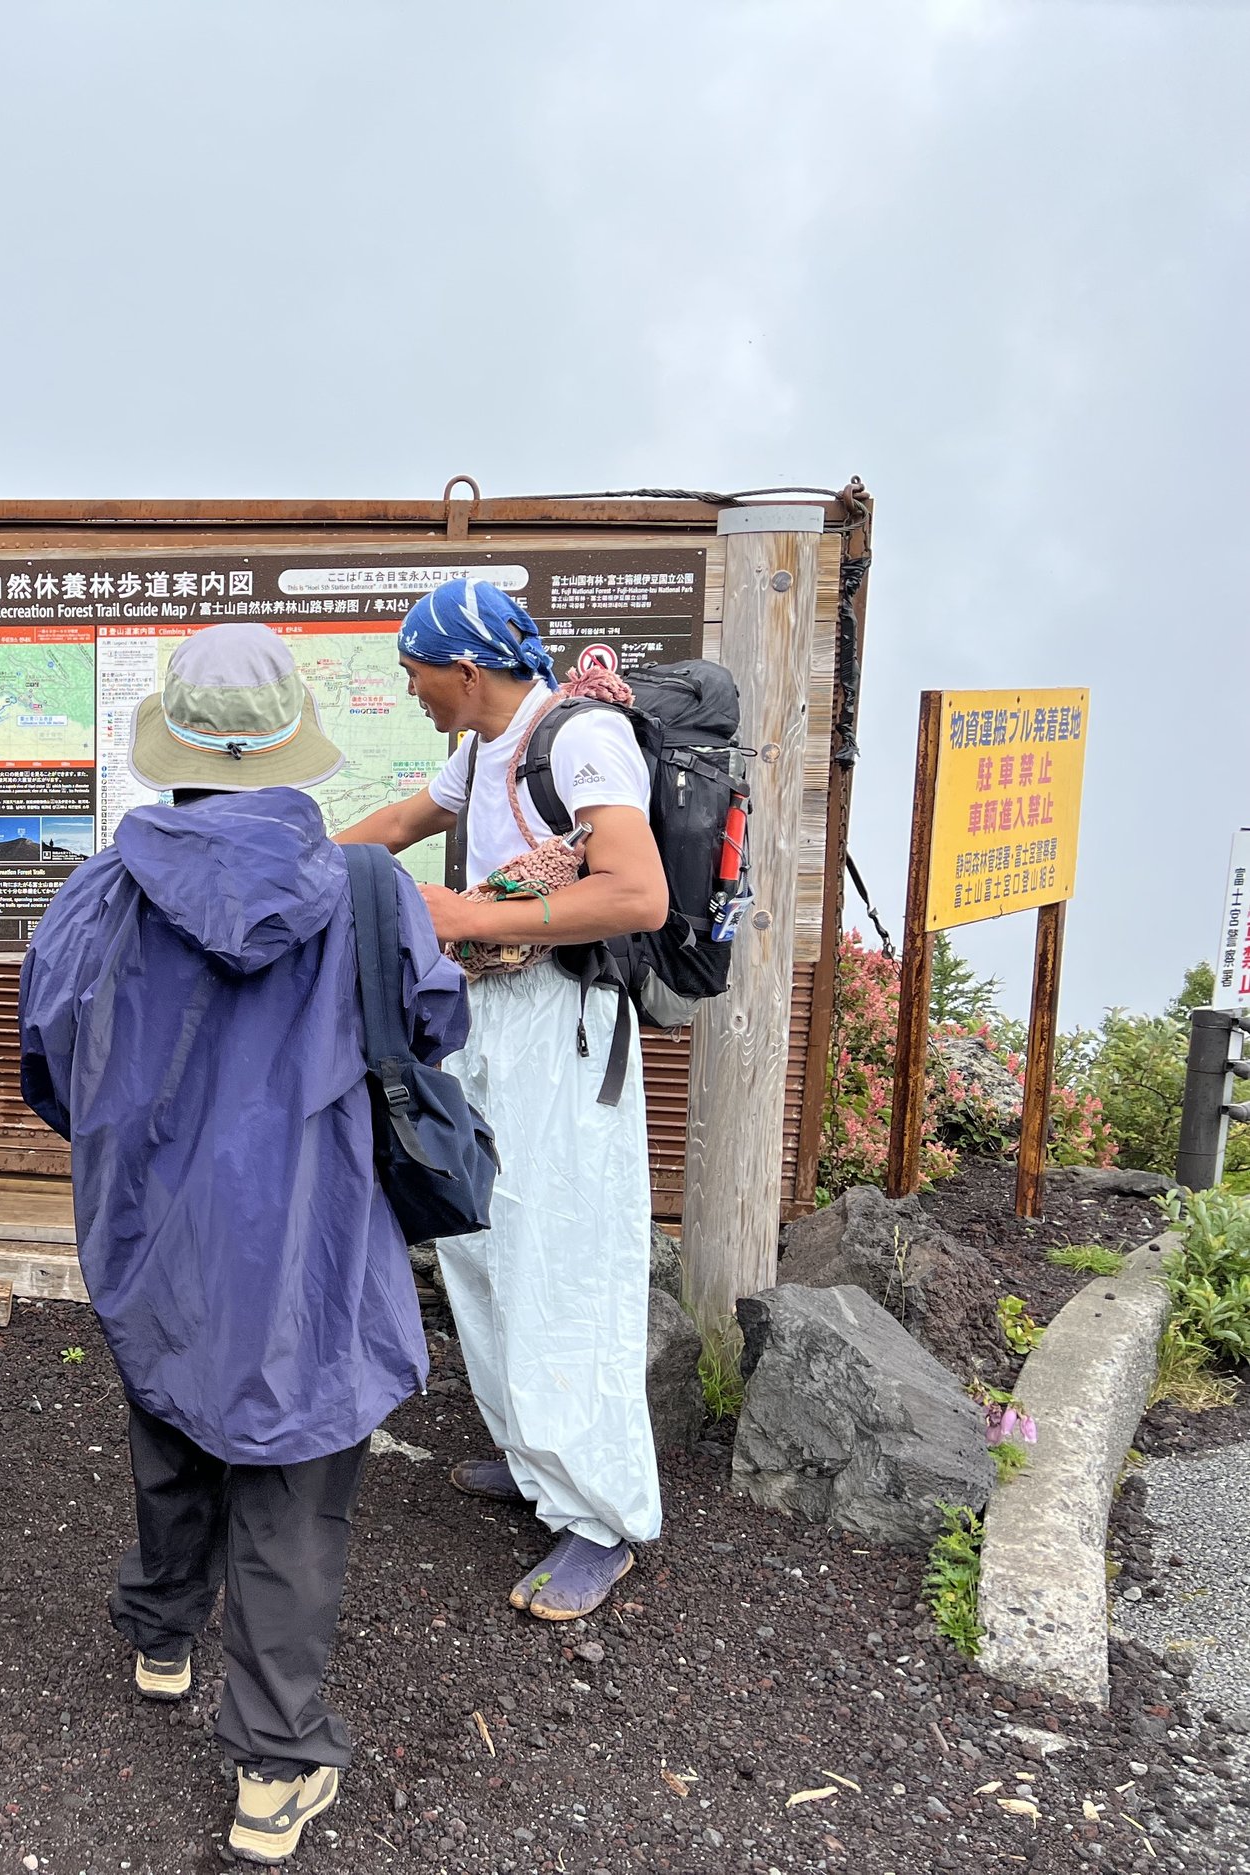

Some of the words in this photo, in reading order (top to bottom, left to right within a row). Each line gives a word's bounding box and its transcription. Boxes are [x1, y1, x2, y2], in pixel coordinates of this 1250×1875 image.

[58, 602, 93, 618] Forest
[96, 602, 120, 617] Trail
[124, 602, 159, 617] Guide
[162, 602, 188, 620] Map
[373, 600, 410, 614] 후지산
[159, 628, 186, 636] Climbing
[621, 642, 664, 652] キャンプ禁止
[950, 705, 1082, 749] 物資運搬ブル発着基地
[573, 774, 606, 787] adidas
[976, 751, 1053, 792] 駐車禁止
[956, 837, 1058, 879] 静岡森林管理署・富士宮警察署
[954, 864, 1055, 908] 富士山富士宮口登山組合
[1221, 867, 1246, 988] 富士宮警察署
